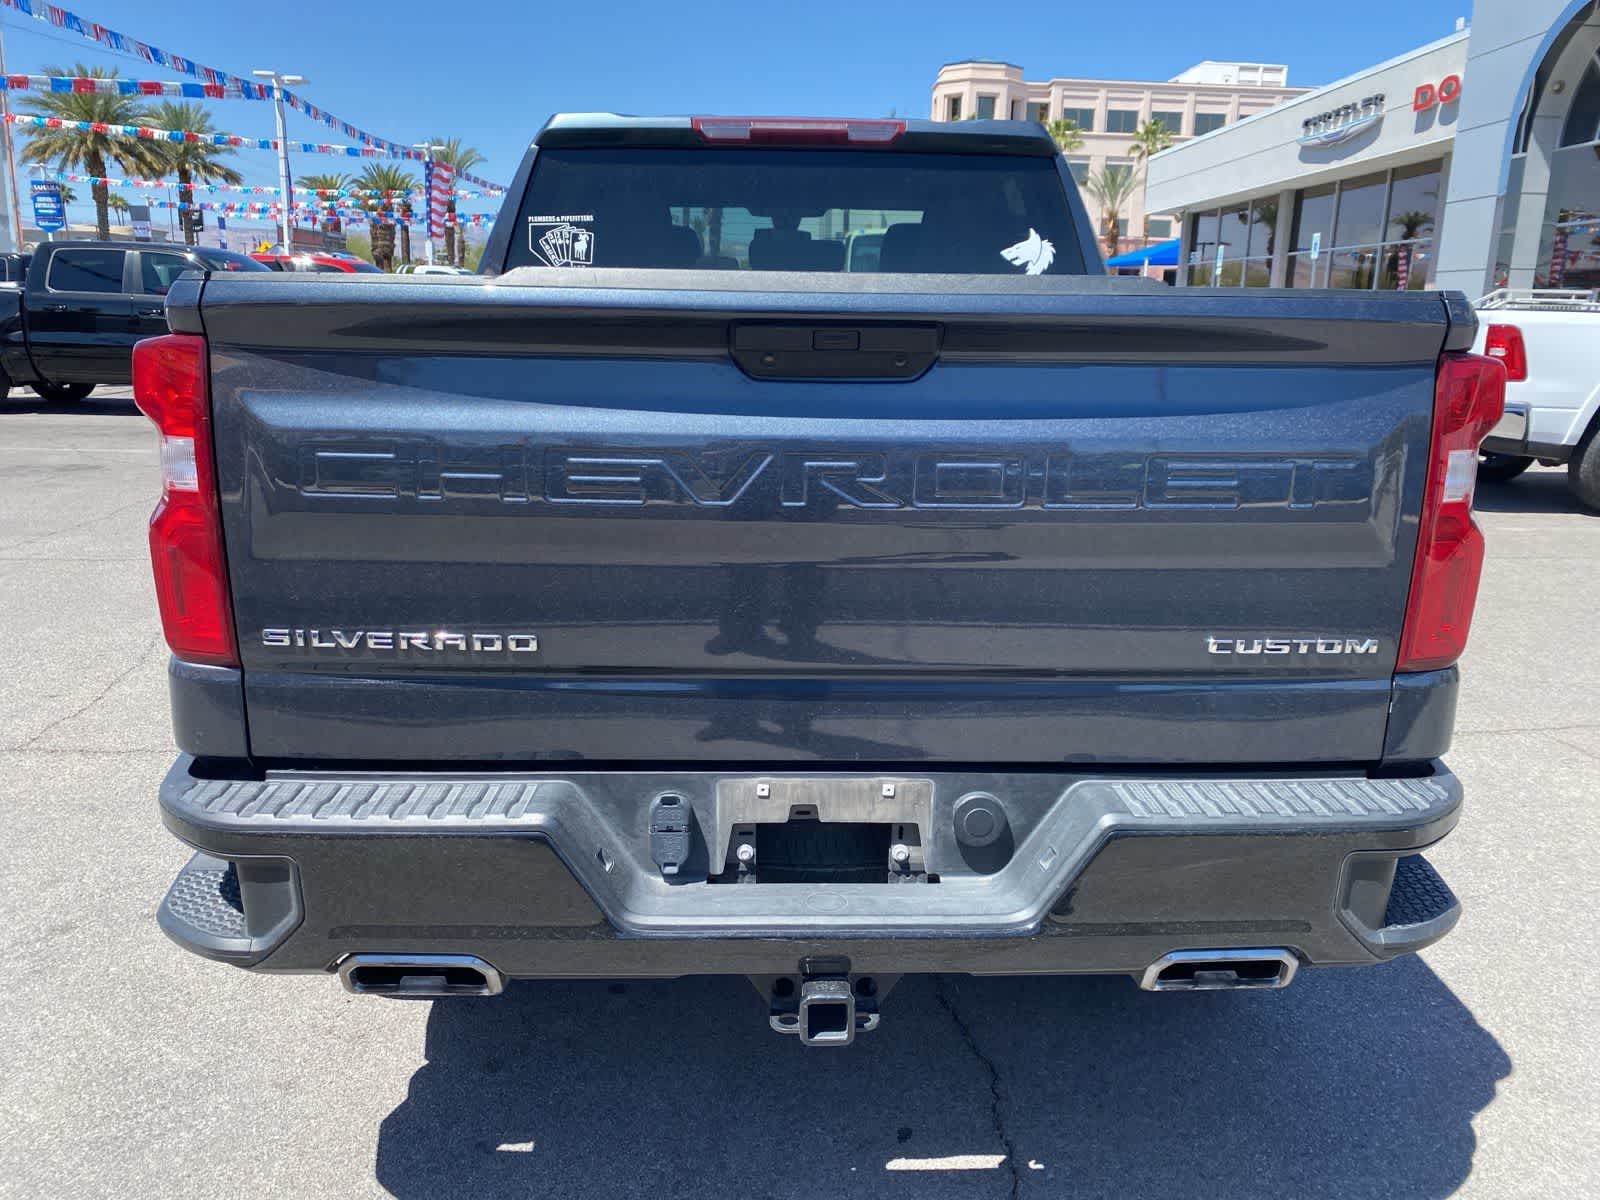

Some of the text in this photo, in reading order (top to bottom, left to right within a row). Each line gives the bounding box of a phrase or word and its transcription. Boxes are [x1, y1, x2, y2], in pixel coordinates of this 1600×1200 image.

[298, 440, 1362, 511] CHEVROLET
[262, 628, 538, 652] SILVERADO
[1207, 637, 1379, 654] CUSTOM
